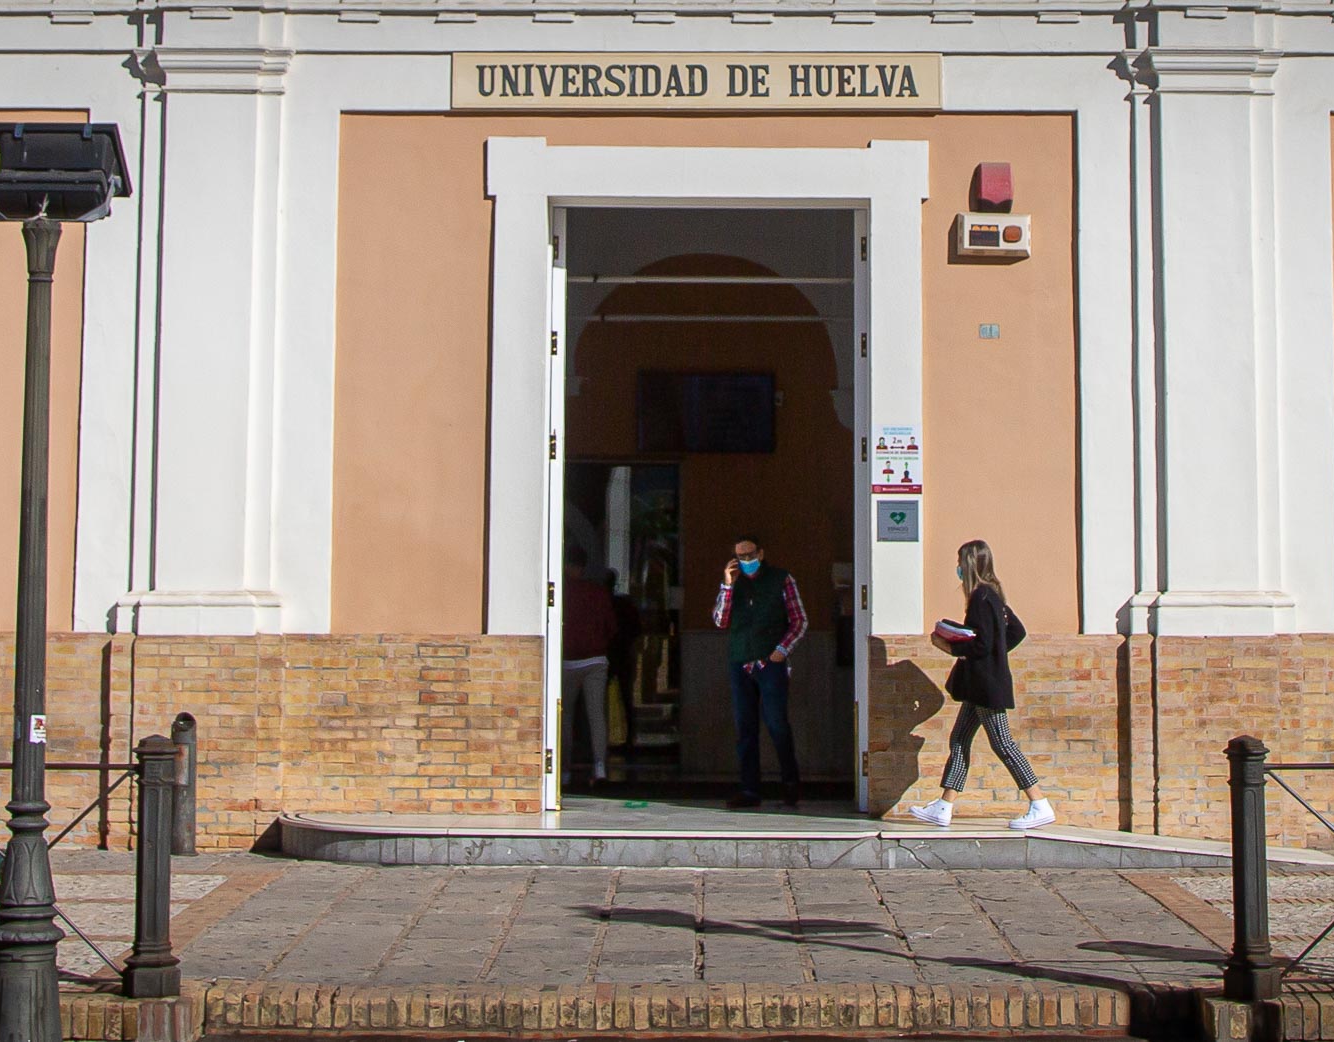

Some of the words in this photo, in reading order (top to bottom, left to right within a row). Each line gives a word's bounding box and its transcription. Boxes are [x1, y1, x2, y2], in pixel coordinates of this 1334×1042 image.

[475, 64, 708, 98] UNIVERSIDAD
[726, 64, 770, 98] DE
[788, 64, 920, 98] HUELVA
